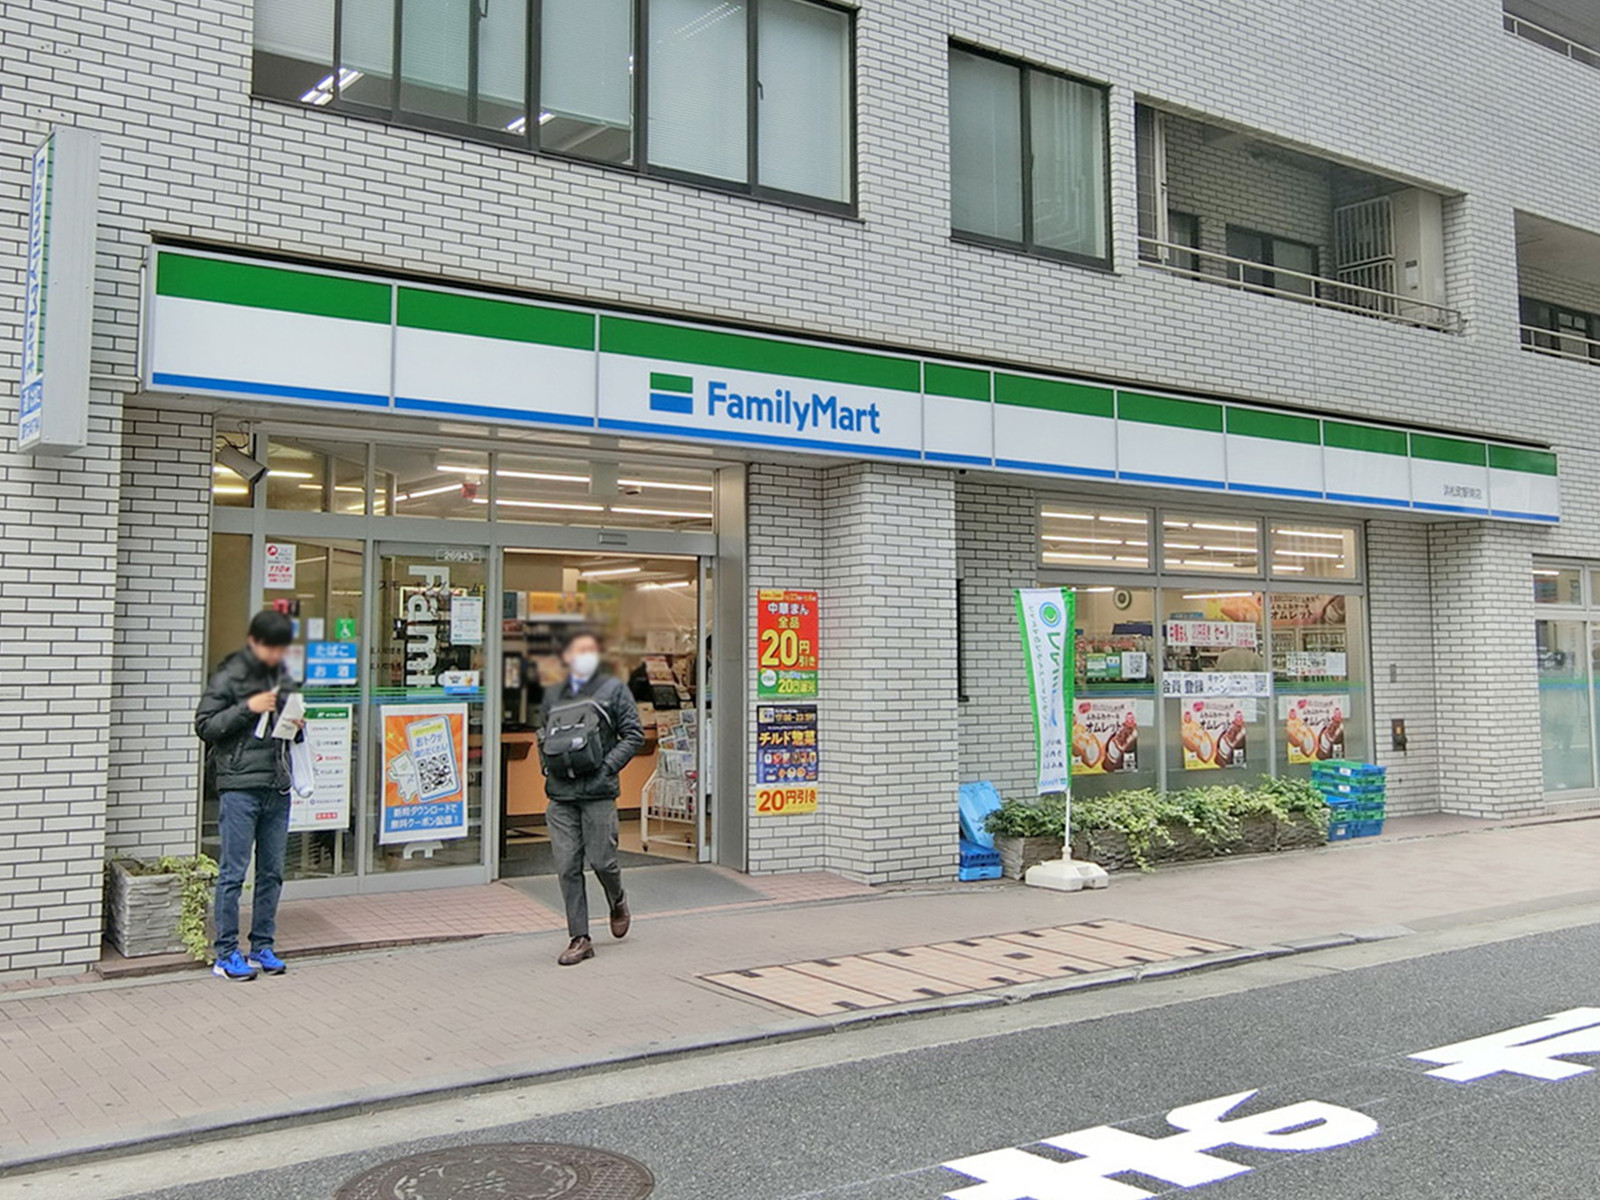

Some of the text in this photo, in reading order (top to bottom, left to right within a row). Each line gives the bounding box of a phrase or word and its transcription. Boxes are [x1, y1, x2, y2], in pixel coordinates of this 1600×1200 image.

[708, 381, 880, 434] FamilyMart
[767, 603, 809, 615] 中華まん
[778, 616, 800, 629] 全品
[315, 643, 350, 658] たばこ
[761, 629, 798, 667] 20
[1085, 720, 1121, 733] オムレット
[1199, 719, 1231, 731] オムレット
[1303, 715, 1331, 727] オムレット
[759, 730, 816, 747] チルド惣菜
[758, 790, 816, 812] 20円引き
